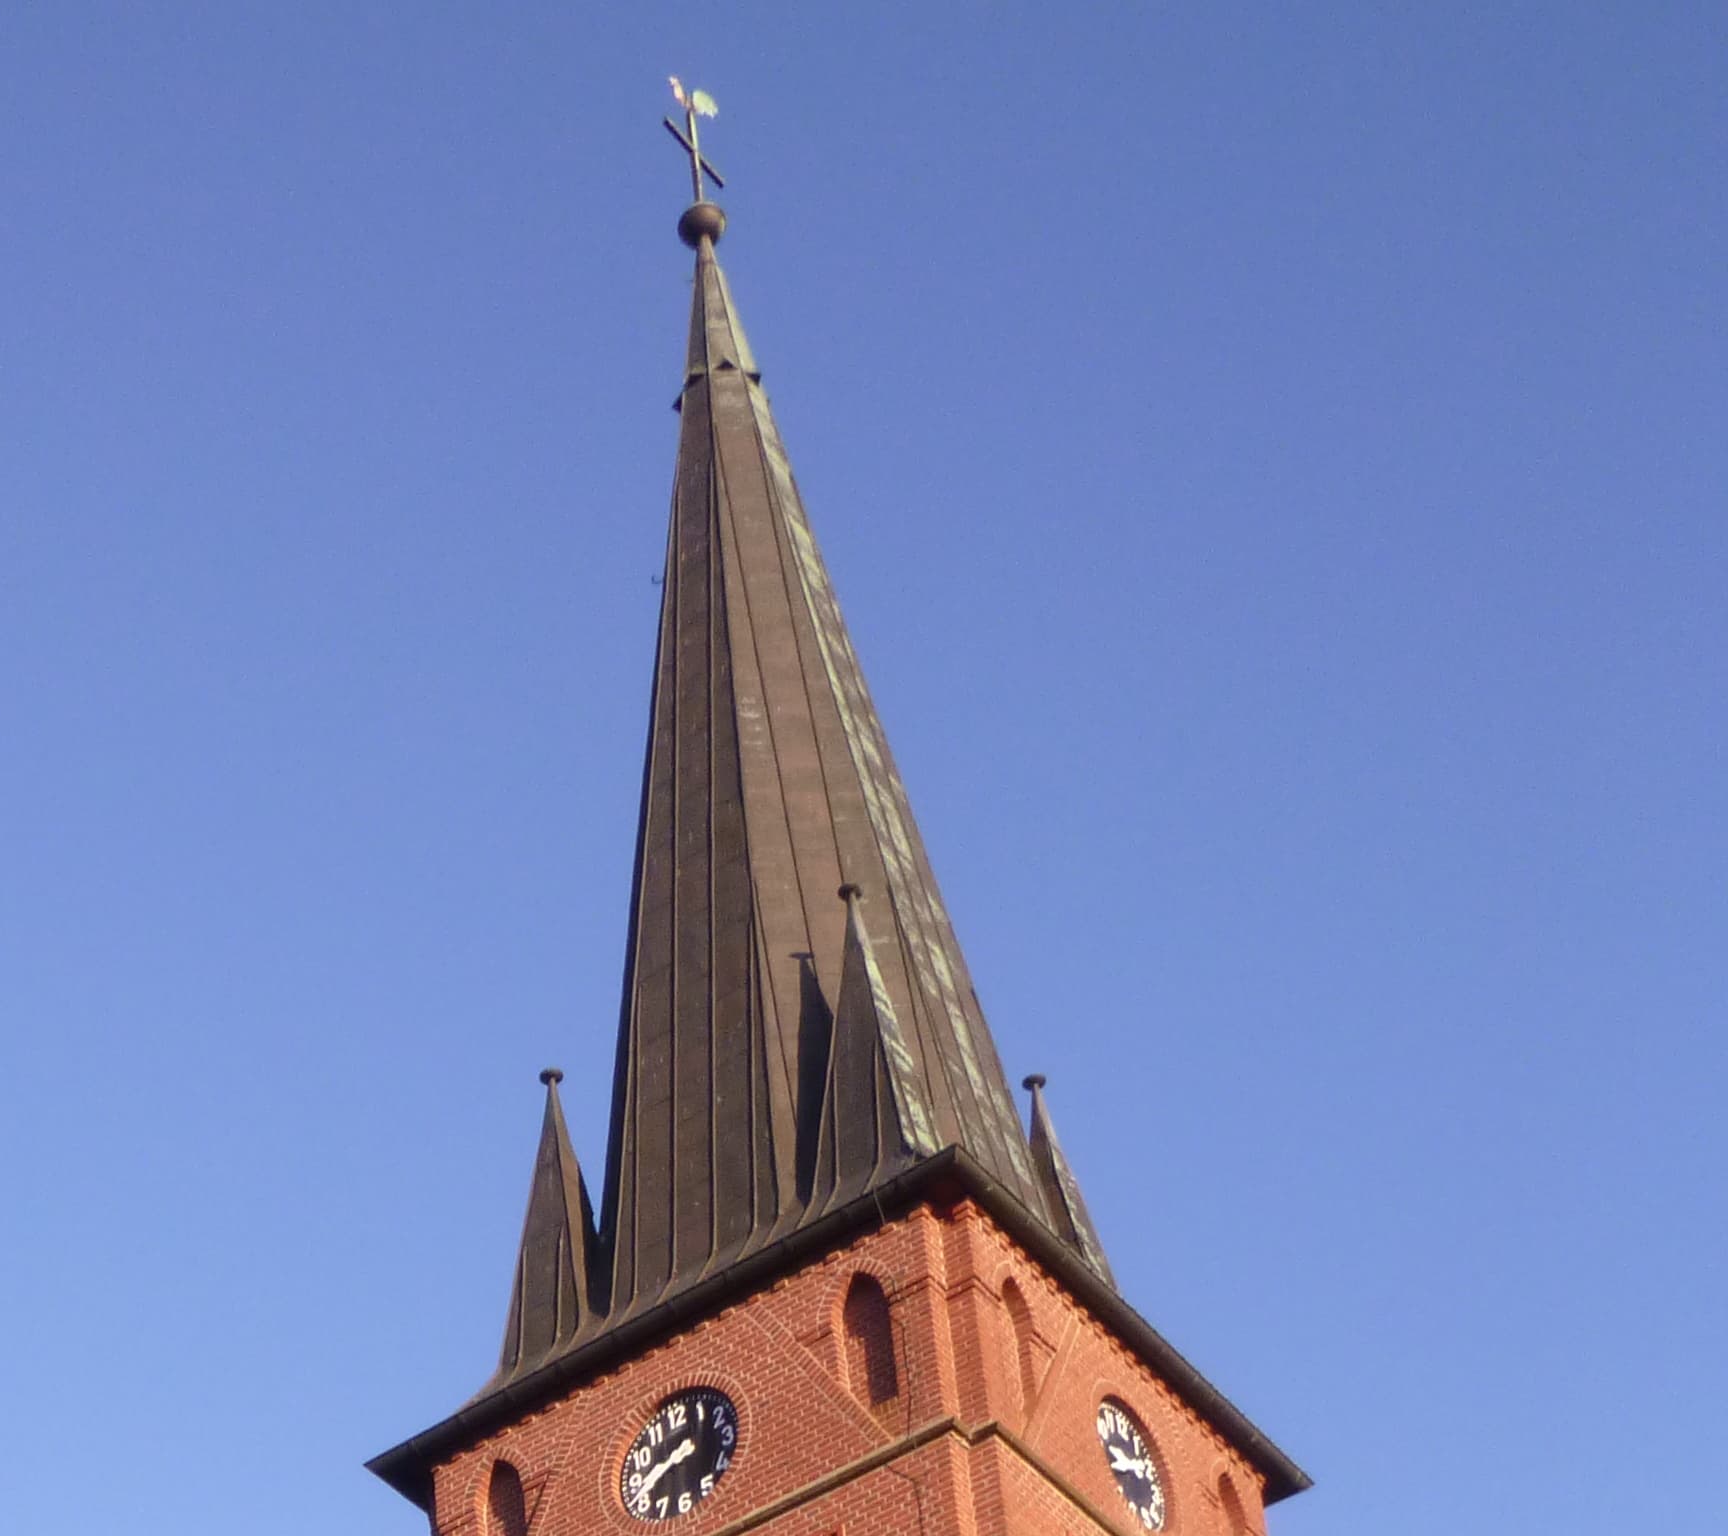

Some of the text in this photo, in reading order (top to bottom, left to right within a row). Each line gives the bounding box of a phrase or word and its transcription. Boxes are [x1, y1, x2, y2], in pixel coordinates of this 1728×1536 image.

[667, 1405, 687, 1430] 12
[696, 1401, 705, 1421] 1
[712, 1405, 725, 1429] 2
[648, 1423, 663, 1446] 11
[721, 1425, 734, 1446] 3
[633, 1446, 651, 1470] 10
[715, 1451, 730, 1471] 4
[629, 1473, 642, 1495] 9
[700, 1474, 714, 1497] 5
[637, 1492, 650, 1513] 8
[656, 1496, 669, 1519] 7
[678, 1492, 692, 1513] 6
